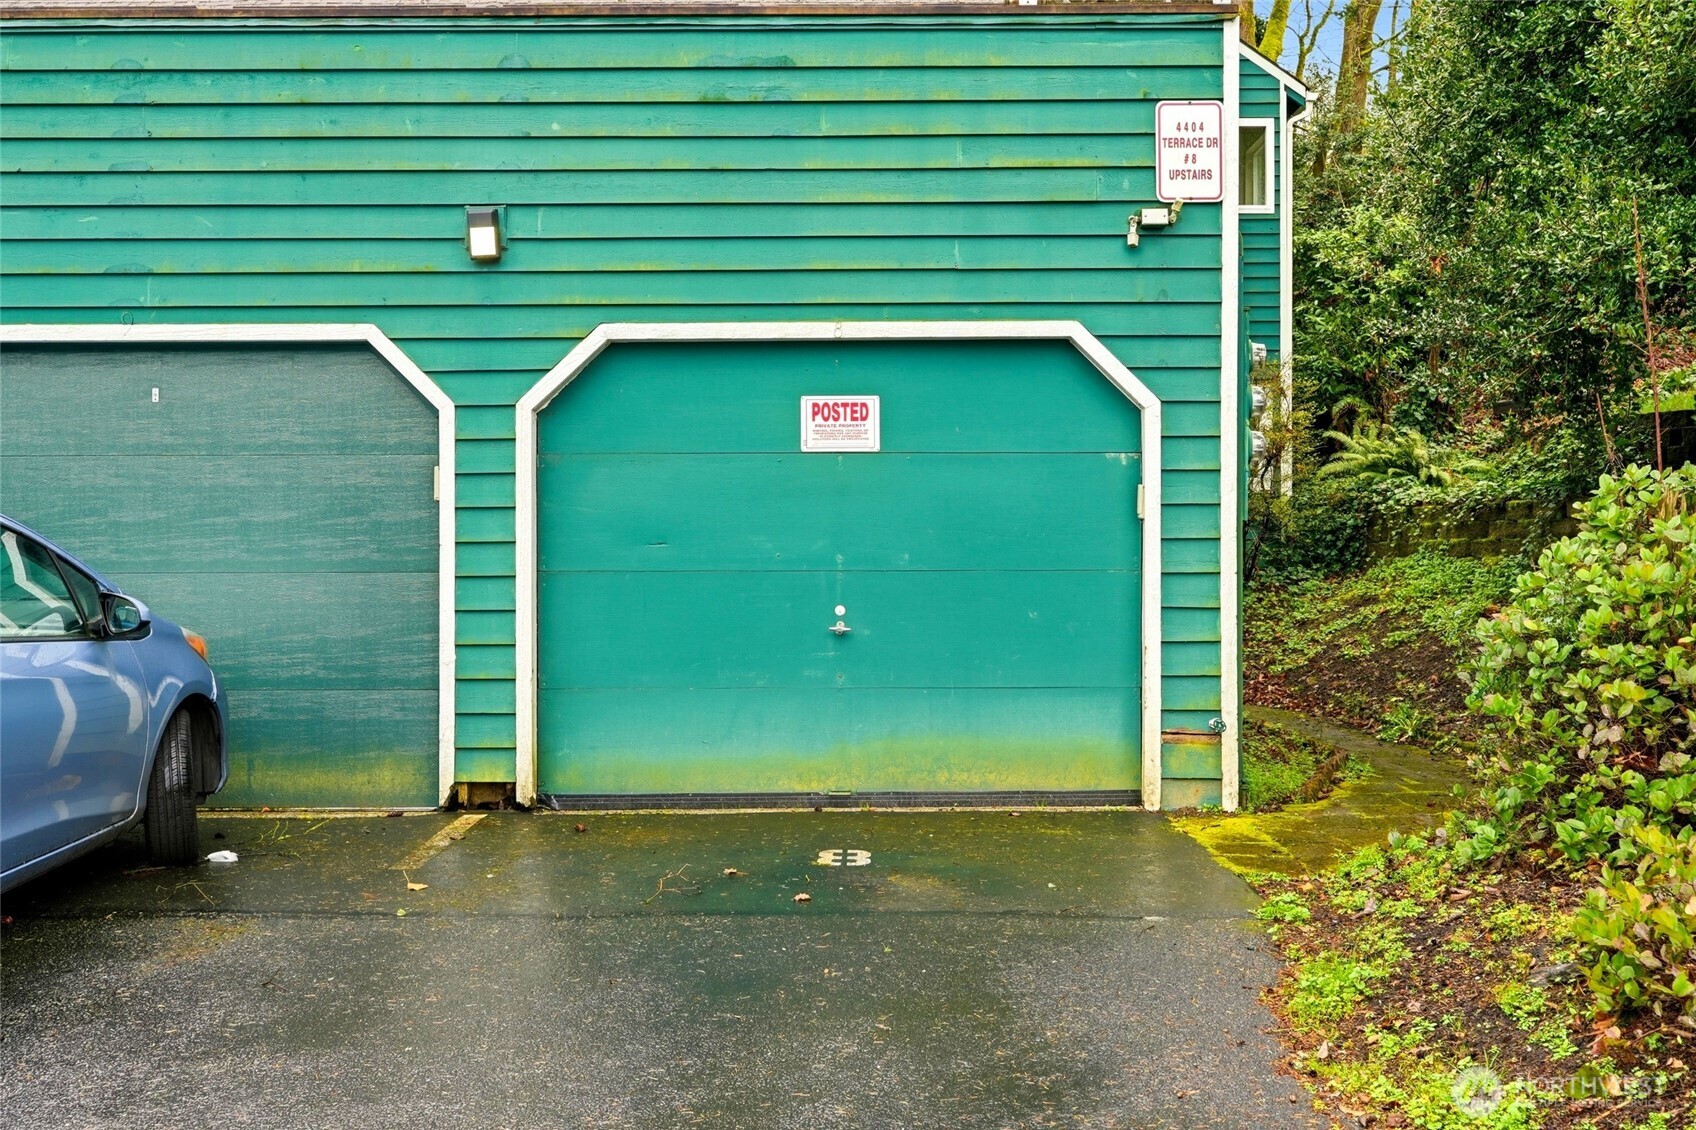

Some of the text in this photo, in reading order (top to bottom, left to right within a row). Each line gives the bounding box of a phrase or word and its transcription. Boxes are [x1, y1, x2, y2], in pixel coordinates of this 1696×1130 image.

[1176, 121, 1204, 132] 4404
[1162, 137, 1219, 148] TERRACE DR
[1168, 169, 1213, 180] UPSTAIRS
[811, 401, 870, 422] POSTED
